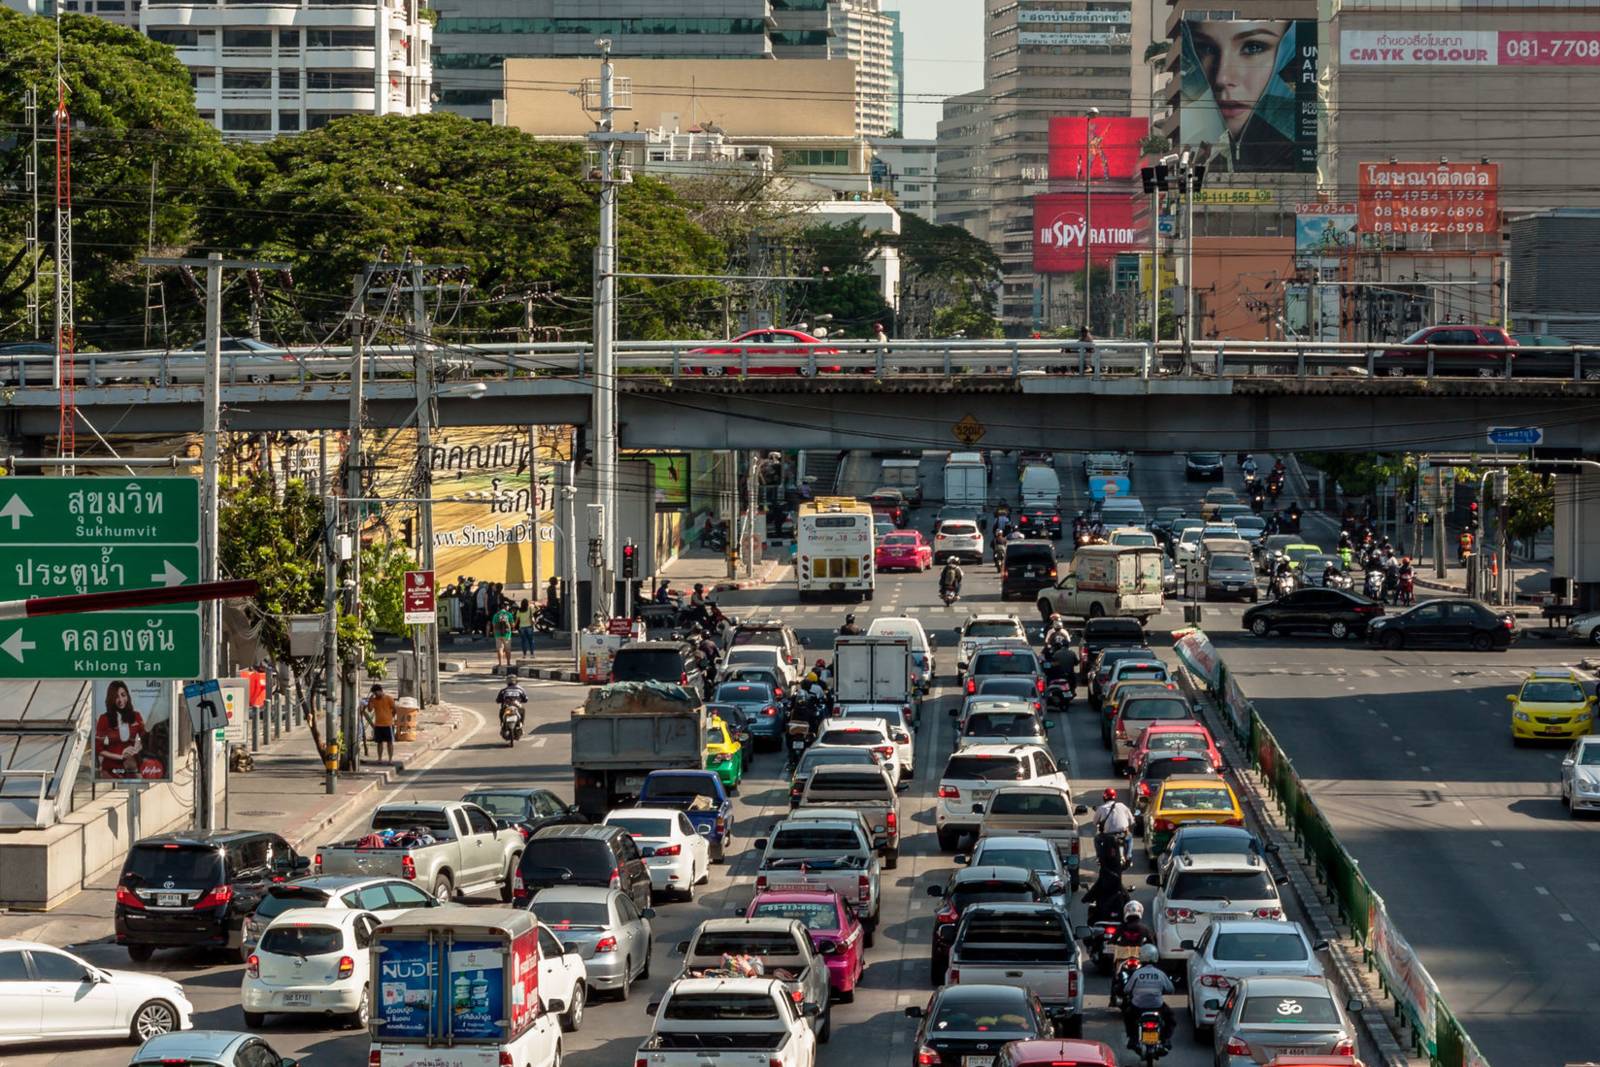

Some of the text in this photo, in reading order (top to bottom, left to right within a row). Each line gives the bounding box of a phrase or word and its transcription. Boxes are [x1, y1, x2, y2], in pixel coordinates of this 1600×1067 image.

[1350, 48, 1488, 61] CMYK COLOUR
[1367, 165, 1489, 186] โฆษณาติดต่อ
[1374, 206, 1485, 217] 08-8689-6896
[1374, 222, 1485, 233] 08-1842-6898
[68, 482, 163, 524] สุขุมวิท
[76, 526, 157, 537] Sukhumvit
[16, 547, 124, 594] ประตูน้ำ
[61, 620, 175, 652] คลองตัน
[74, 660, 161, 673] Khlong Tan
[382, 962, 440, 978] NUDE
